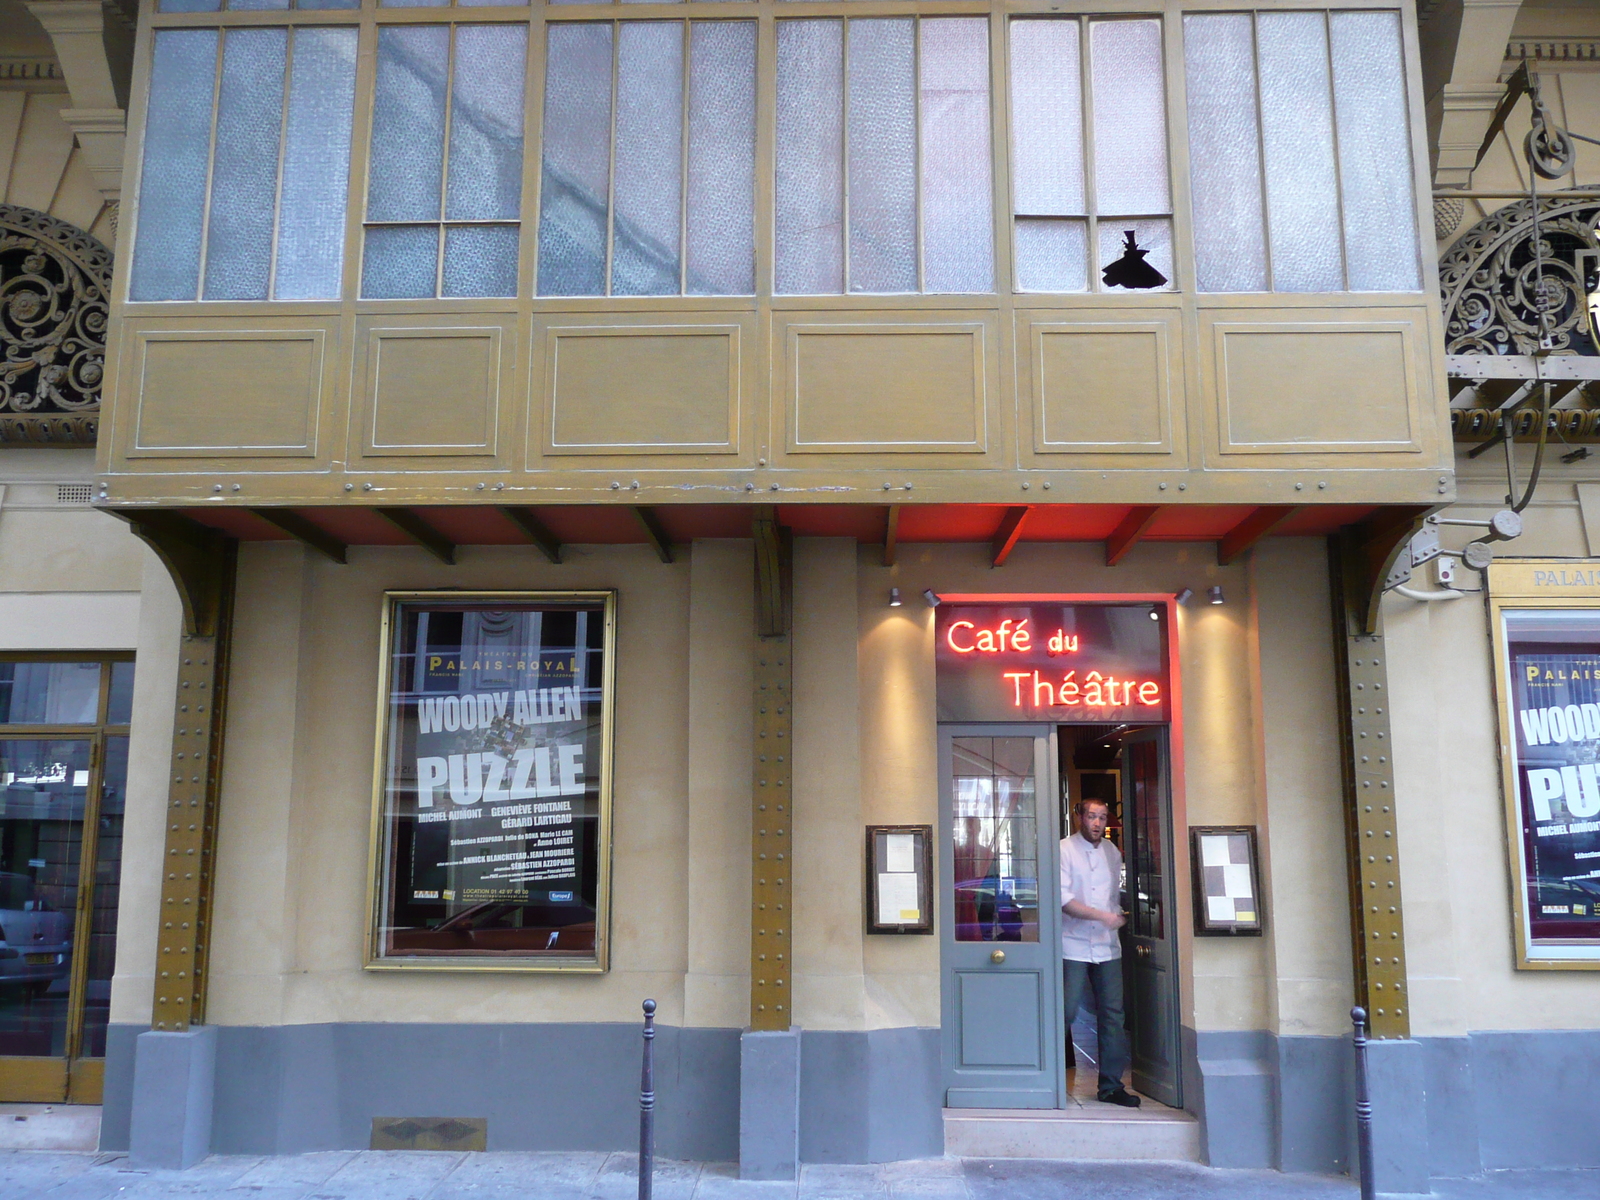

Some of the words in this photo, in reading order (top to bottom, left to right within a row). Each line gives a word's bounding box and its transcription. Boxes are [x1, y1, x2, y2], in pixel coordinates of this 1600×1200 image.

[948, 618, 1032, 652] Café
[1048, 629, 1078, 651] du
[430, 657, 580, 672] PALAIS-ROYAL
[1003, 670, 1161, 706] Théâtre
[418, 691, 509, 734] WOODY
[513, 685, 582, 726] ALLEN
[1520, 702, 1600, 746] WOOD
[416, 744, 586, 808] PUZZLE
[1527, 763, 1600, 822] PU
[418, 811, 447, 823] MICHEL
[449, 808, 482, 821] AUMONT
[501, 817, 533, 829] GÉRARD
[534, 813, 572, 826] LARTIGAU
[533, 801, 572, 813] FONTANEL
[1537, 824, 1569, 837] MICHEL
